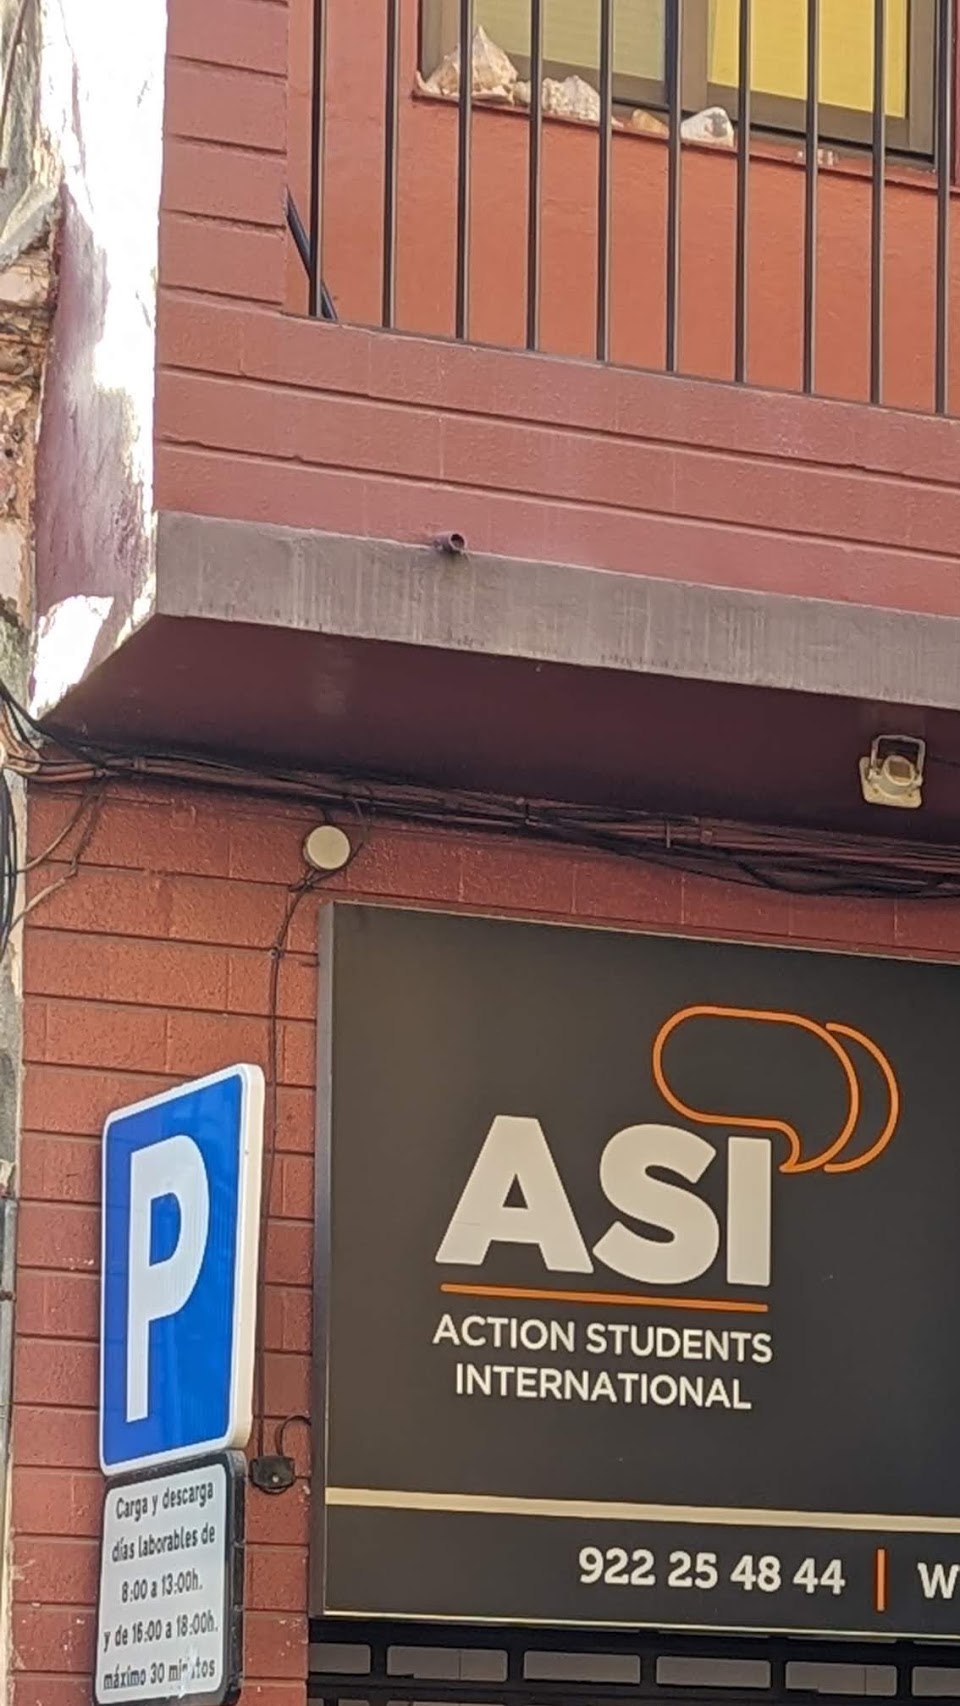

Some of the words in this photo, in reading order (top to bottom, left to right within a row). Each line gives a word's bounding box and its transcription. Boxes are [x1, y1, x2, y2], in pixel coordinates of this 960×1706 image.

[435, 1115, 771, 1286] ASI
[127, 1135, 209, 1422] P
[433, 1314, 574, 1351] ACTION
[587, 1323, 772, 1362] STUDENTS
[457, 1364, 751, 1409] INTERNATIONAL
[116, 1497, 148, 1522] Carga
[152, 1493, 158, 1516] y
[163, 1481, 213, 1510] descarga
[112, 1537, 135, 1562] días
[138, 1525, 198, 1559] laborables
[201, 1522, 215, 1544] de
[122, 1579, 148, 1603] 8:00
[151, 1581, 157, 1598] a
[161, 1568, 203, 1596] 13:00h.
[580, 1547, 655, 1585] 922
[668, 1551, 717, 1588] 25
[731, 1555, 781, 1591] 48
[793, 1558, 845, 1594] 44
[104, 1630, 111, 1652] y
[115, 1624, 128, 1646] de
[132, 1620, 162, 1643] 16:00
[165, 1622, 172, 1638] a
[176, 1610, 218, 1636] 18:00h.
[104, 1663, 146, 1690] máximo
[150, 1662, 165, 1682] 30
